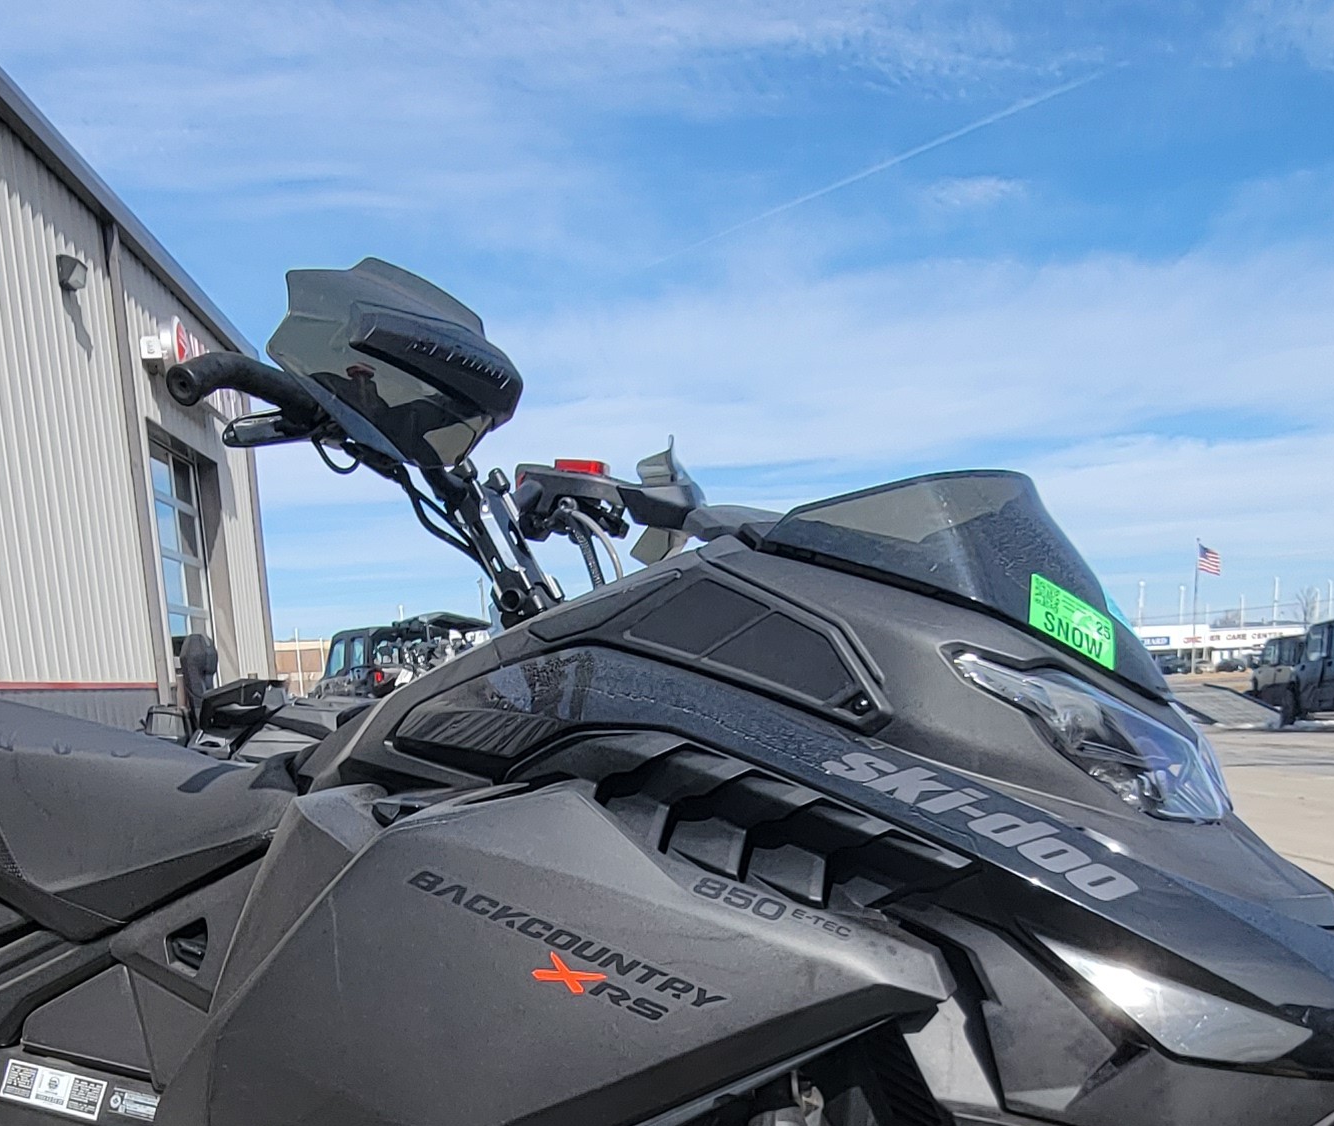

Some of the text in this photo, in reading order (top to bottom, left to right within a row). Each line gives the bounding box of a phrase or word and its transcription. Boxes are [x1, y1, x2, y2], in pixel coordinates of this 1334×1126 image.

[1043, 611, 1103, 659] SNOW
[1096, 621, 1111, 640] 25
[693, 877, 852, 938] 850 E-TEC
[407, 870, 728, 1008] BACKCOUNTRY
